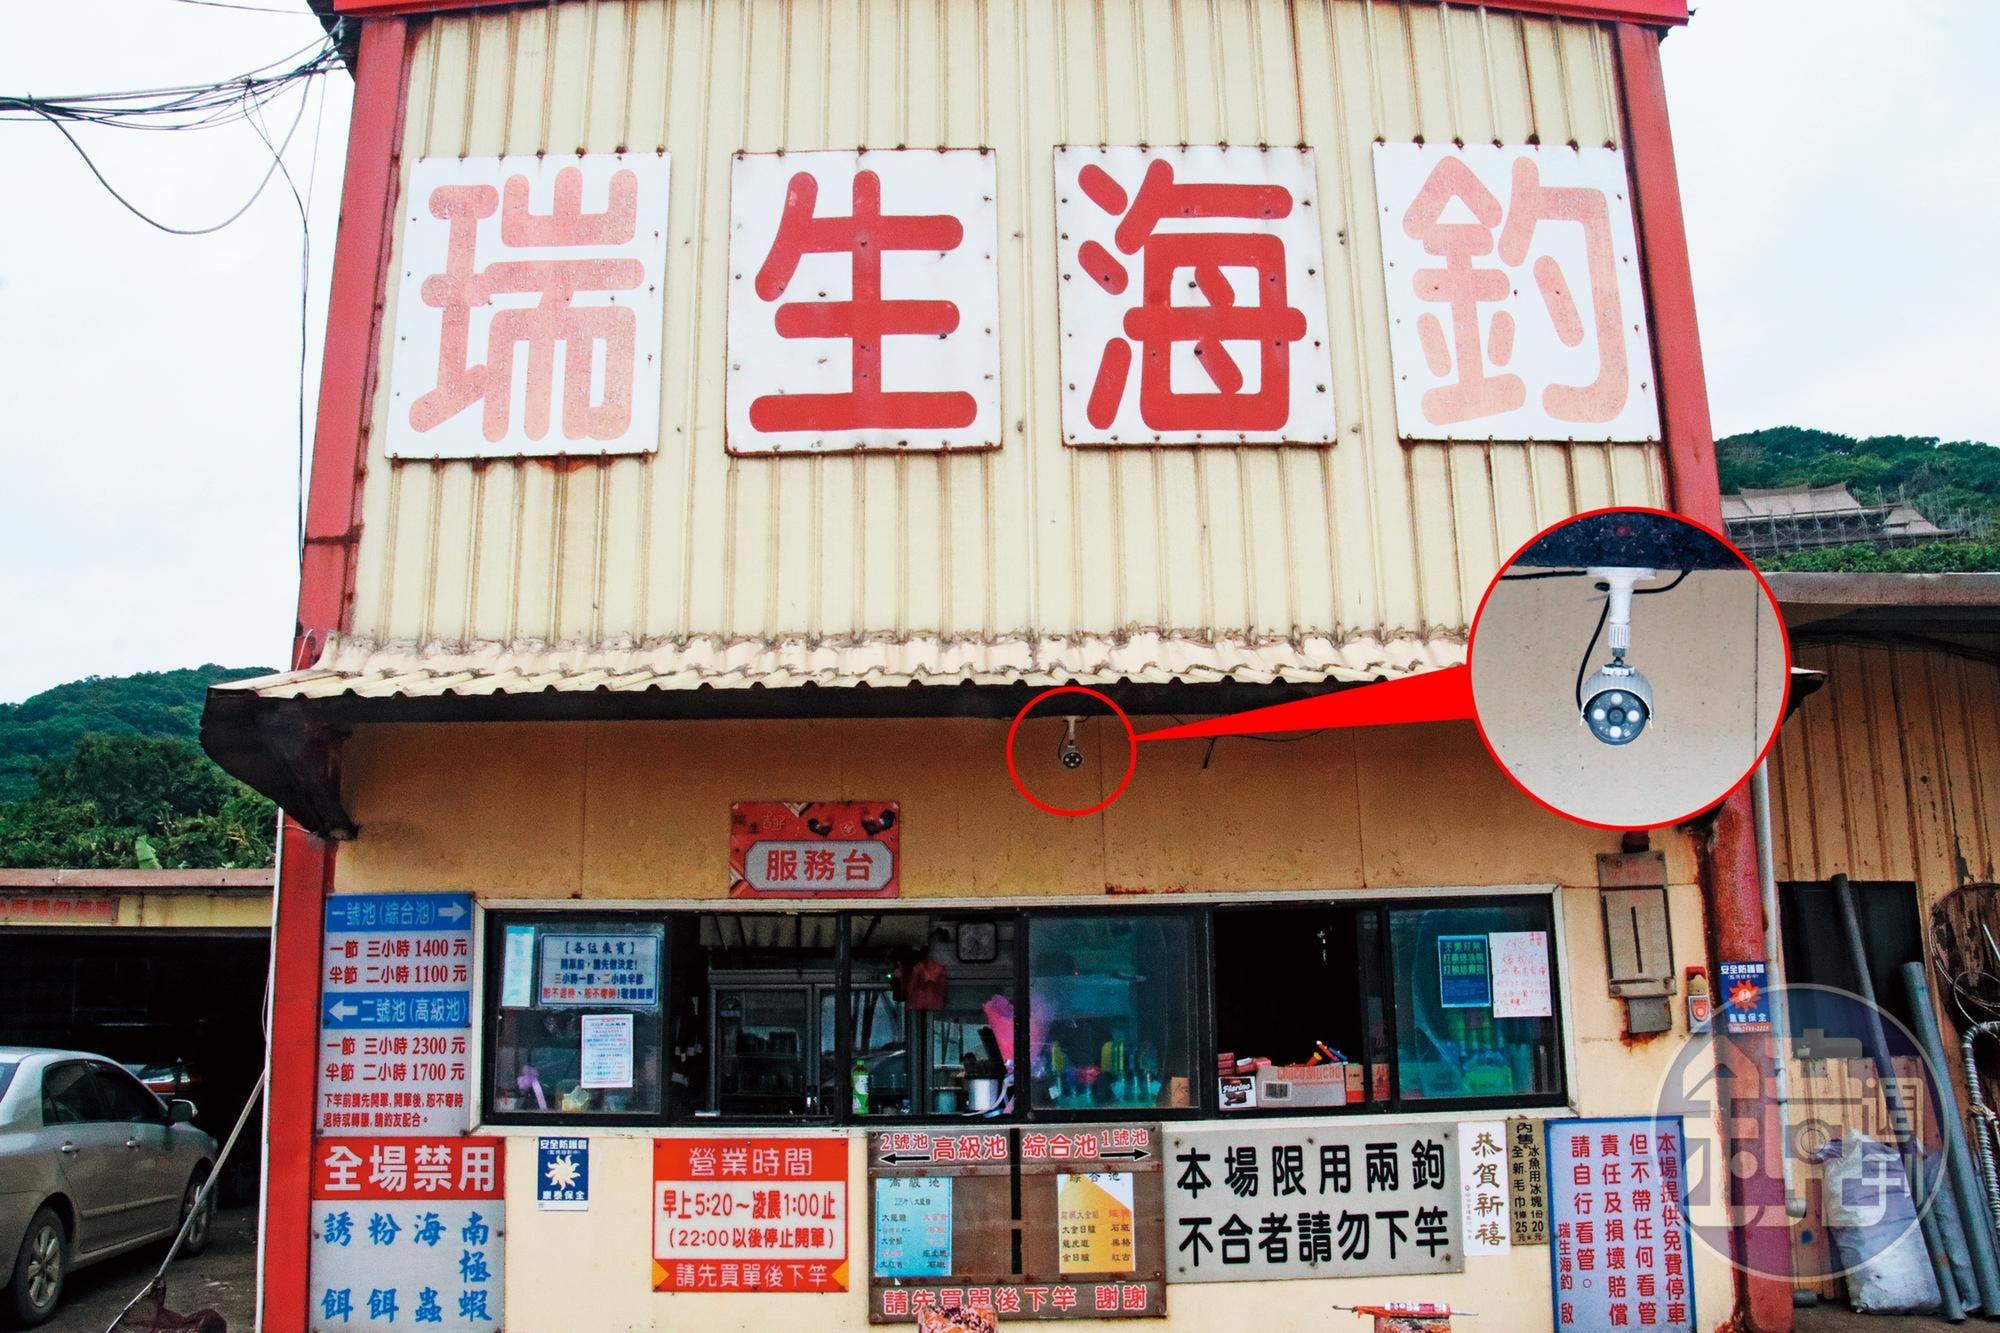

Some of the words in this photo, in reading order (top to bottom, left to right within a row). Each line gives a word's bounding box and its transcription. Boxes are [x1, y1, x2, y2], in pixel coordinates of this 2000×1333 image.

[409, 155, 1627, 442] 瑞生海釣
[766, 850, 874, 881] 服務台
[330, 940, 358, 958] 一節
[367, 939, 410, 957] 三小時
[415, 939, 449, 957] 1400
[453, 939, 467, 956] 元
[330, 966, 358, 984] 半節
[366, 965, 410, 983] 二小時
[415, 965, 449, 983] 1100
[453, 965, 467, 982] 元
[326, 1037, 355, 1055] 一節
[364, 1037, 407, 1055] 三小時
[412, 1037, 447, 1055] 2300
[451, 1037, 466, 1054] 元
[326, 1063, 354, 1082] 半節
[363, 1063, 407, 1081] 二小時
[412, 1063, 446, 1081] 1700
[451, 1063, 465, 1081] 元
[324, 1145, 495, 1193] 全場禁用
[689, 1147, 813, 1177] 營業時間
[881, 1133, 930, 1151] 2號池
[931, 1133, 1007, 1162] 高級池
[1022, 1132, 1098, 1159] 綜合池
[1100, 1128, 1149, 1148] 1號池
[1176, 1138, 1446, 1200] 本場限用兩鉤
[1470, 1131, 1506, 1247] 恭賀新禧
[1177, 1205, 1450, 1267] 不合者請勿下竿
[1557, 1222, 1574, 1291] 瑞生海釣
[1600, 1133, 1629, 1327] 責任及損壞賠償
[1629, 1133, 1657, 1326] 但不帶任何看管
[1656, 1132, 1688, 1326] 本場提供免費停車
[321, 1211, 354, 1323] 誘餌
[366, 1211, 402, 1323] 粉餌
[414, 1210, 446, 1323] 海蟲
[458, 1211, 492, 1322] 南極蝦
[676, 1264, 828, 1288] 請先買單後下竿
[1095, 1284, 1148, 1312] 謝謝
